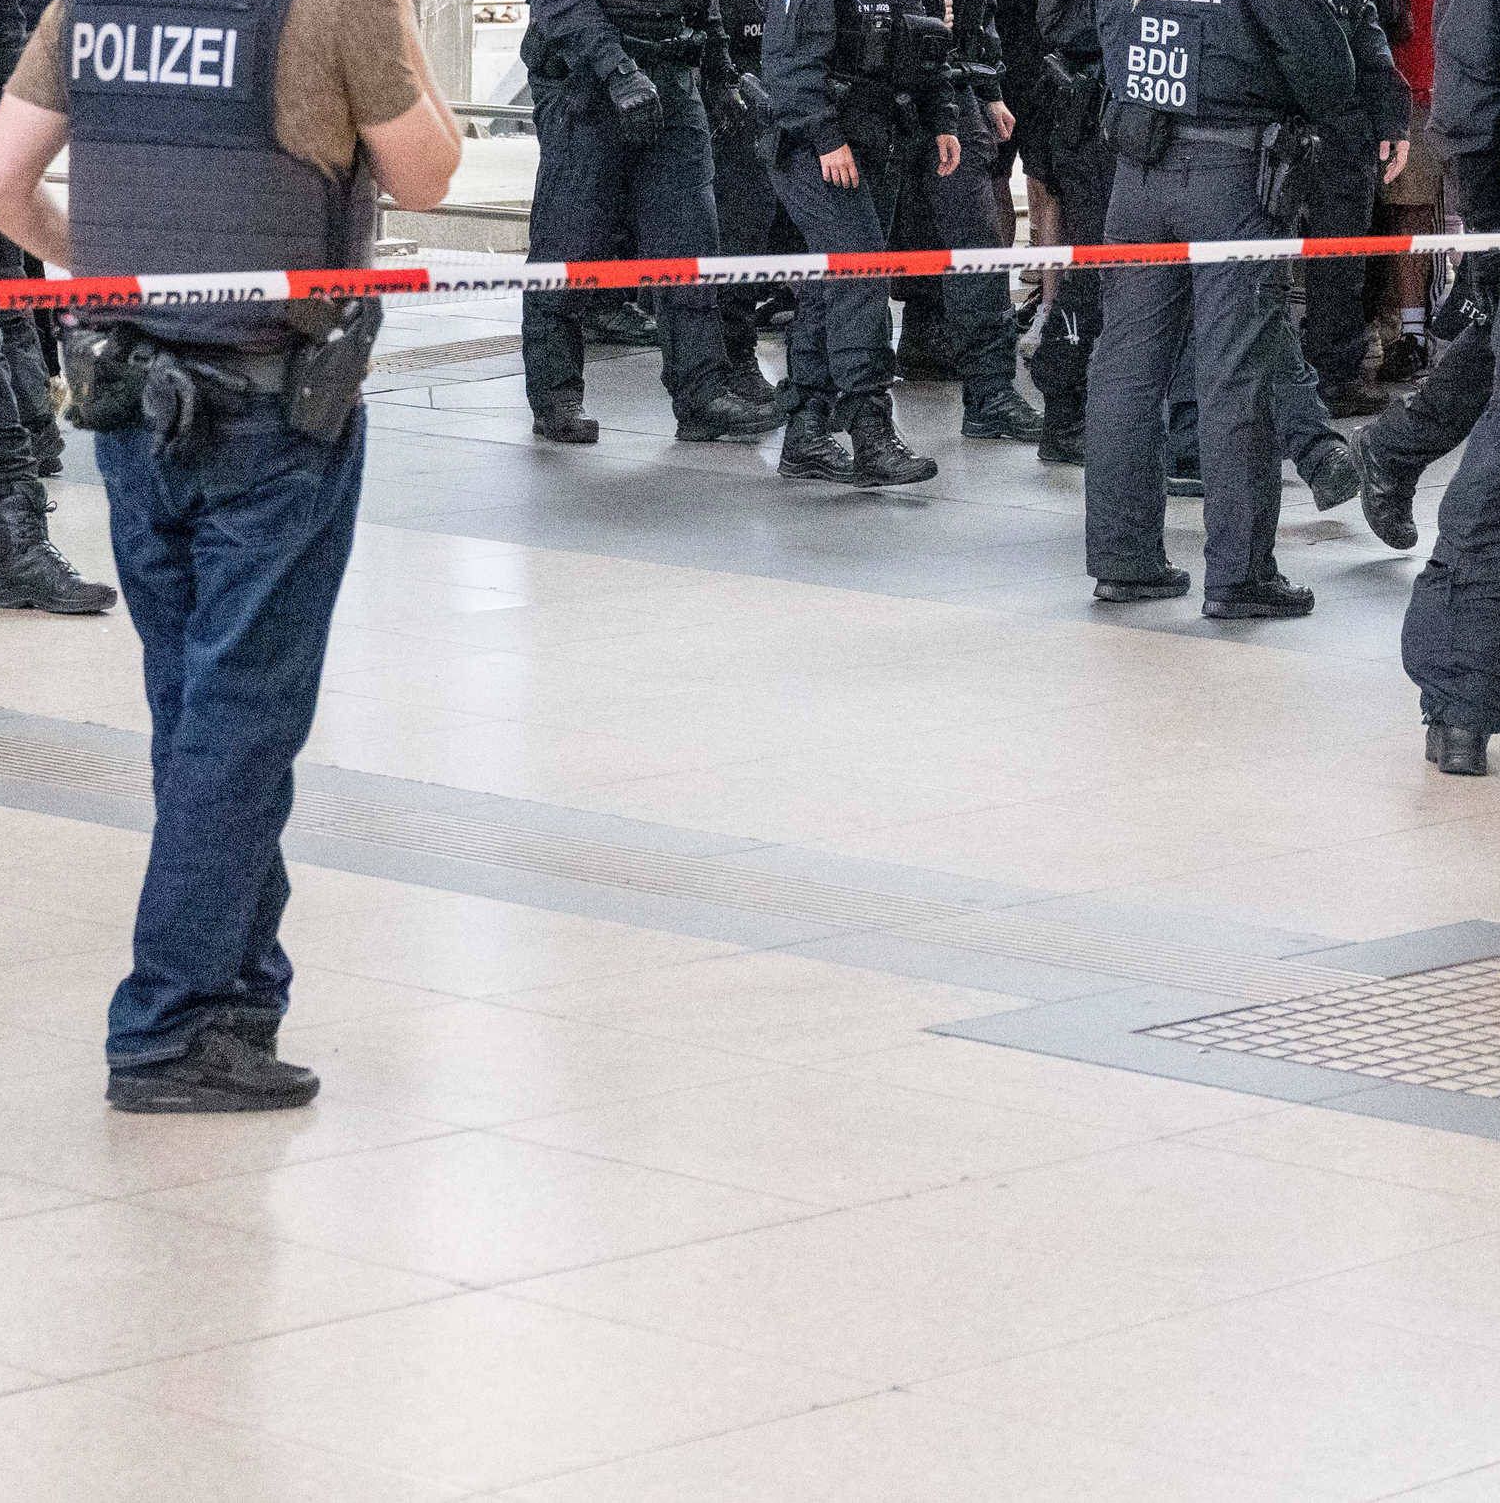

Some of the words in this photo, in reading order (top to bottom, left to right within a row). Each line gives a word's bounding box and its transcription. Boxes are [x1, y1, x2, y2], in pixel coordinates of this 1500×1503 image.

[1141, 16, 1180, 45] BP
[72, 22, 238, 89] POLIZEI
[1128, 45, 1188, 79] BDÜ
[1127, 74, 1186, 107] 5300
